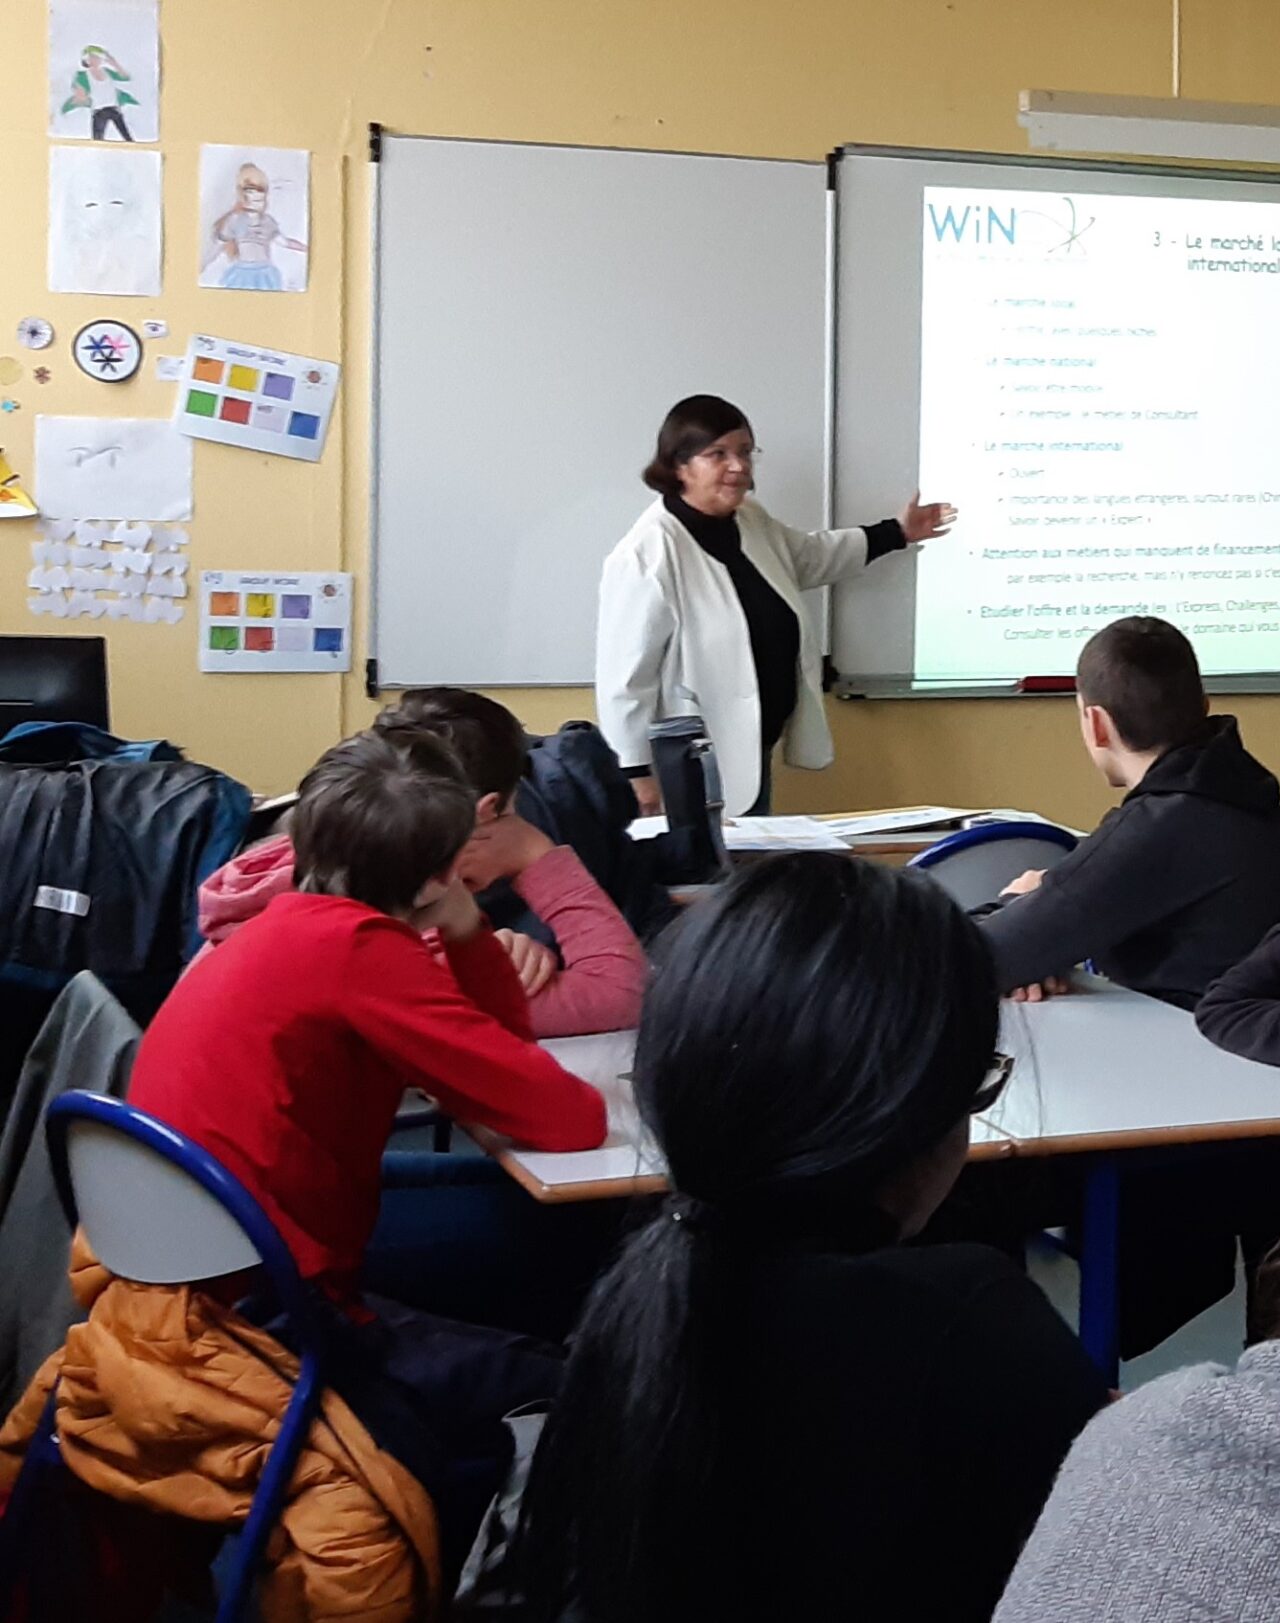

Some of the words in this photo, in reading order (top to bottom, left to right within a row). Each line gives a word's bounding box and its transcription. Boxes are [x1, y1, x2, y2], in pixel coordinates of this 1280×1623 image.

[927, 203, 1015, 245] WiN
[1152, 230, 1161, 248] 3
[1185, 232, 1203, 250] Le
[1210, 234, 1264, 251] marché
[1187, 256, 1280, 274] international
[984, 439, 997, 452] Le
[1048, 440, 1124, 452] international
[982, 547, 1038, 560] Attention
[1042, 548, 1063, 559] aux
[1066, 546, 1110, 559] métiers
[1113, 546, 1132, 560] qui
[1135, 545, 1194, 559] manquent
[1196, 544, 1210, 556] de
[1027, 602, 1062, 617] l'offre
[1065, 602, 1078, 616] et
[1080, 602, 1091, 616] la
[1093, 600, 1149, 616] demande
[1004, 628, 1054, 642] Consulter
[1057, 627, 1072, 641] les
[1193, 622, 1237, 636] domaine
[1257, 621, 1279, 634] vous
